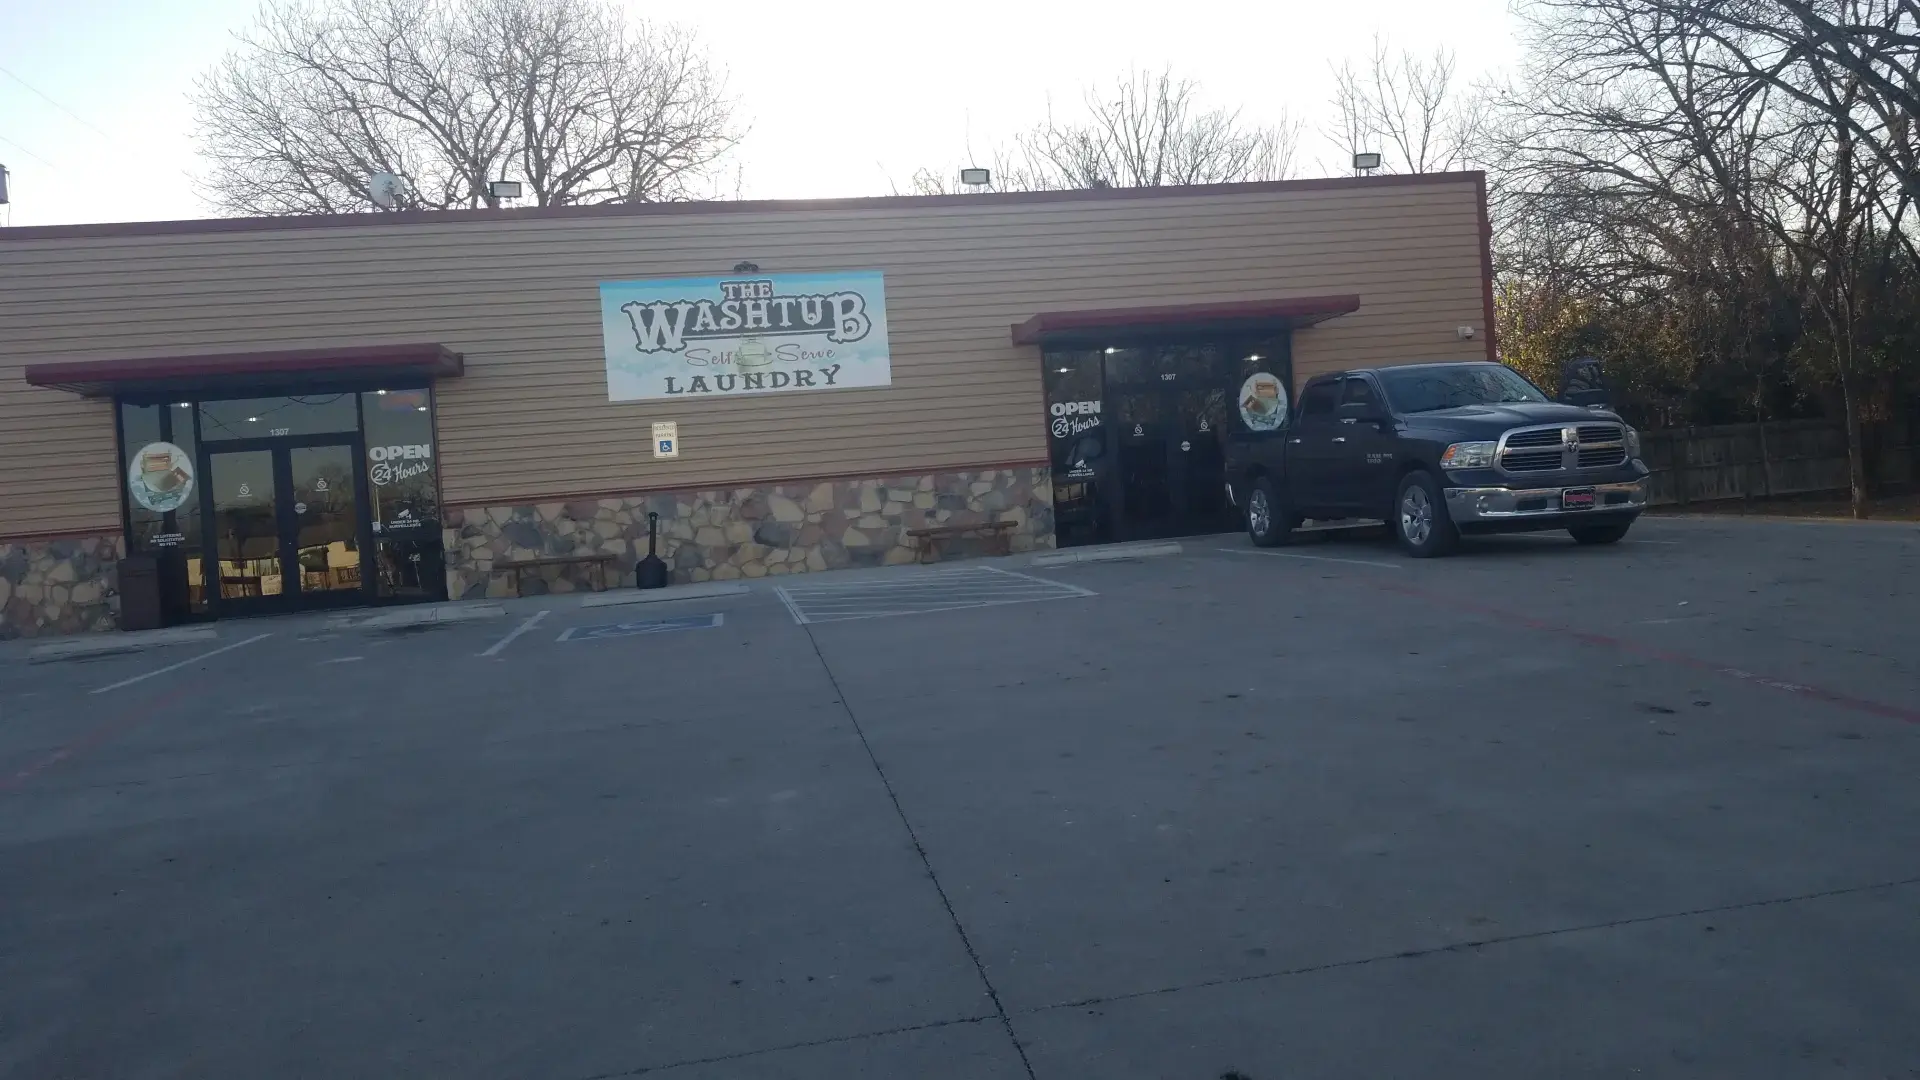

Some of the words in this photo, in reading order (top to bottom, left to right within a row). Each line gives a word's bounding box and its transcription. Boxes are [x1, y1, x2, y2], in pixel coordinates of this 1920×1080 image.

[721, 281, 772, 300] THE
[621, 291, 871, 353] WASHTUB
[684, 347, 735, 368] Self
[775, 343, 836, 363] Serve
[664, 364, 842, 395] LAUNDRY
[1050, 400, 1101, 417] OPEN
[269, 427, 290, 437] 1307
[1069, 415, 1101, 436] Hours
[369, 444, 431, 462] OPEN
[374, 468, 392, 481] 24
[391, 460, 430, 483] Hours
